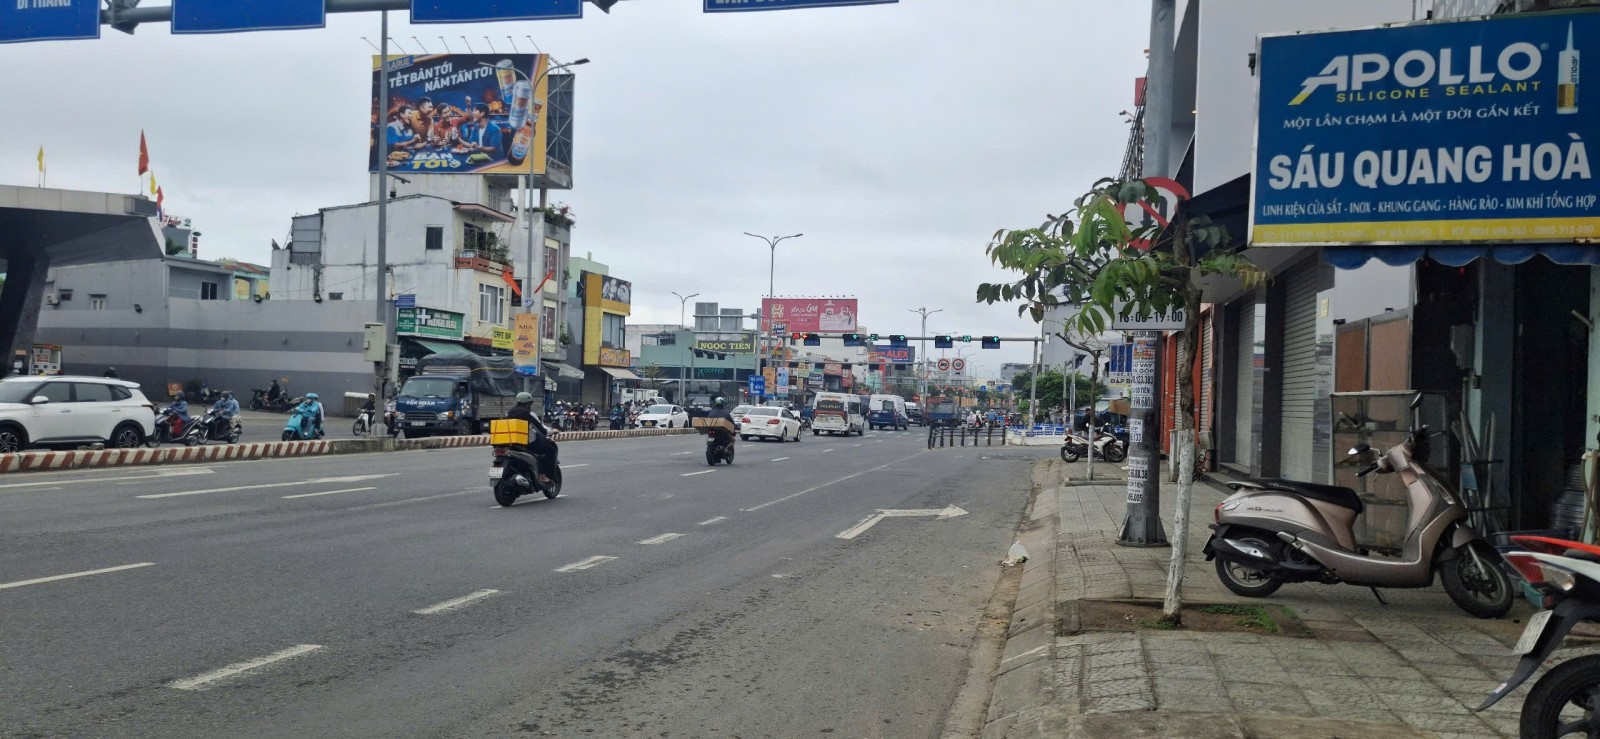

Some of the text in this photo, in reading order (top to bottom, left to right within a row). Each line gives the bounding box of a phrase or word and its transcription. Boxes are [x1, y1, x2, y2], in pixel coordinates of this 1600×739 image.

[410, 66, 434, 83] BÀN
[1288, 42, 1542, 105] APOLLO
[1336, 81, 1542, 103] SILICONE SEALANT
[1283, 116, 1313, 130] MỘT
[1346, 114, 1387, 128] CHẠM
[1391, 110, 1407, 123] LÀ
[1411, 108, 1442, 123] MỘT
[1447, 106, 1472, 120] ĐỜI
[1513, 101, 1541, 116] KẾT
[1268, 132, 1592, 190] SÁU QUANG HOÀ
[1263, 190, 1597, 218] LINH KIỆN CỬA SẮT INOX KHUNG GANG HÀNG RÀO KIM KHÍ TỔNG HỢP
[184, 218, 191, 227] 2
[700, 342, 727, 350] NGỌC
[886, 350, 909, 358] ALEX
